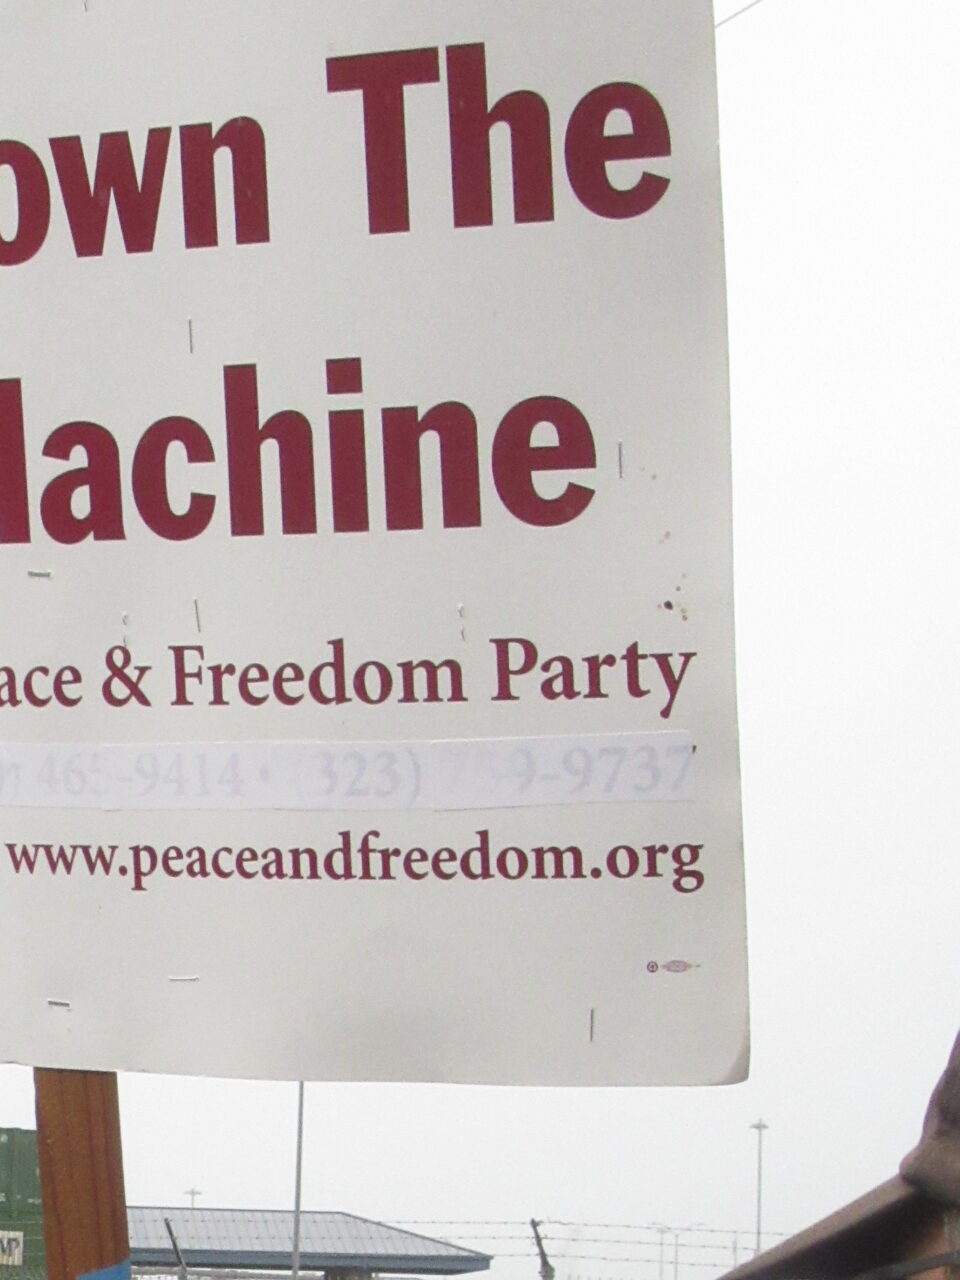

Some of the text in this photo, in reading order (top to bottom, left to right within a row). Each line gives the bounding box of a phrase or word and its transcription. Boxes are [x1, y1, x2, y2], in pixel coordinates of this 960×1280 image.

[327, 44, 670, 235] The
[102, 648, 150, 708] &
[171, 640, 466, 707] Freedom
[492, 638, 697, 718] Party
[5, 829, 705, 894] www.peaceandfreedom.org
